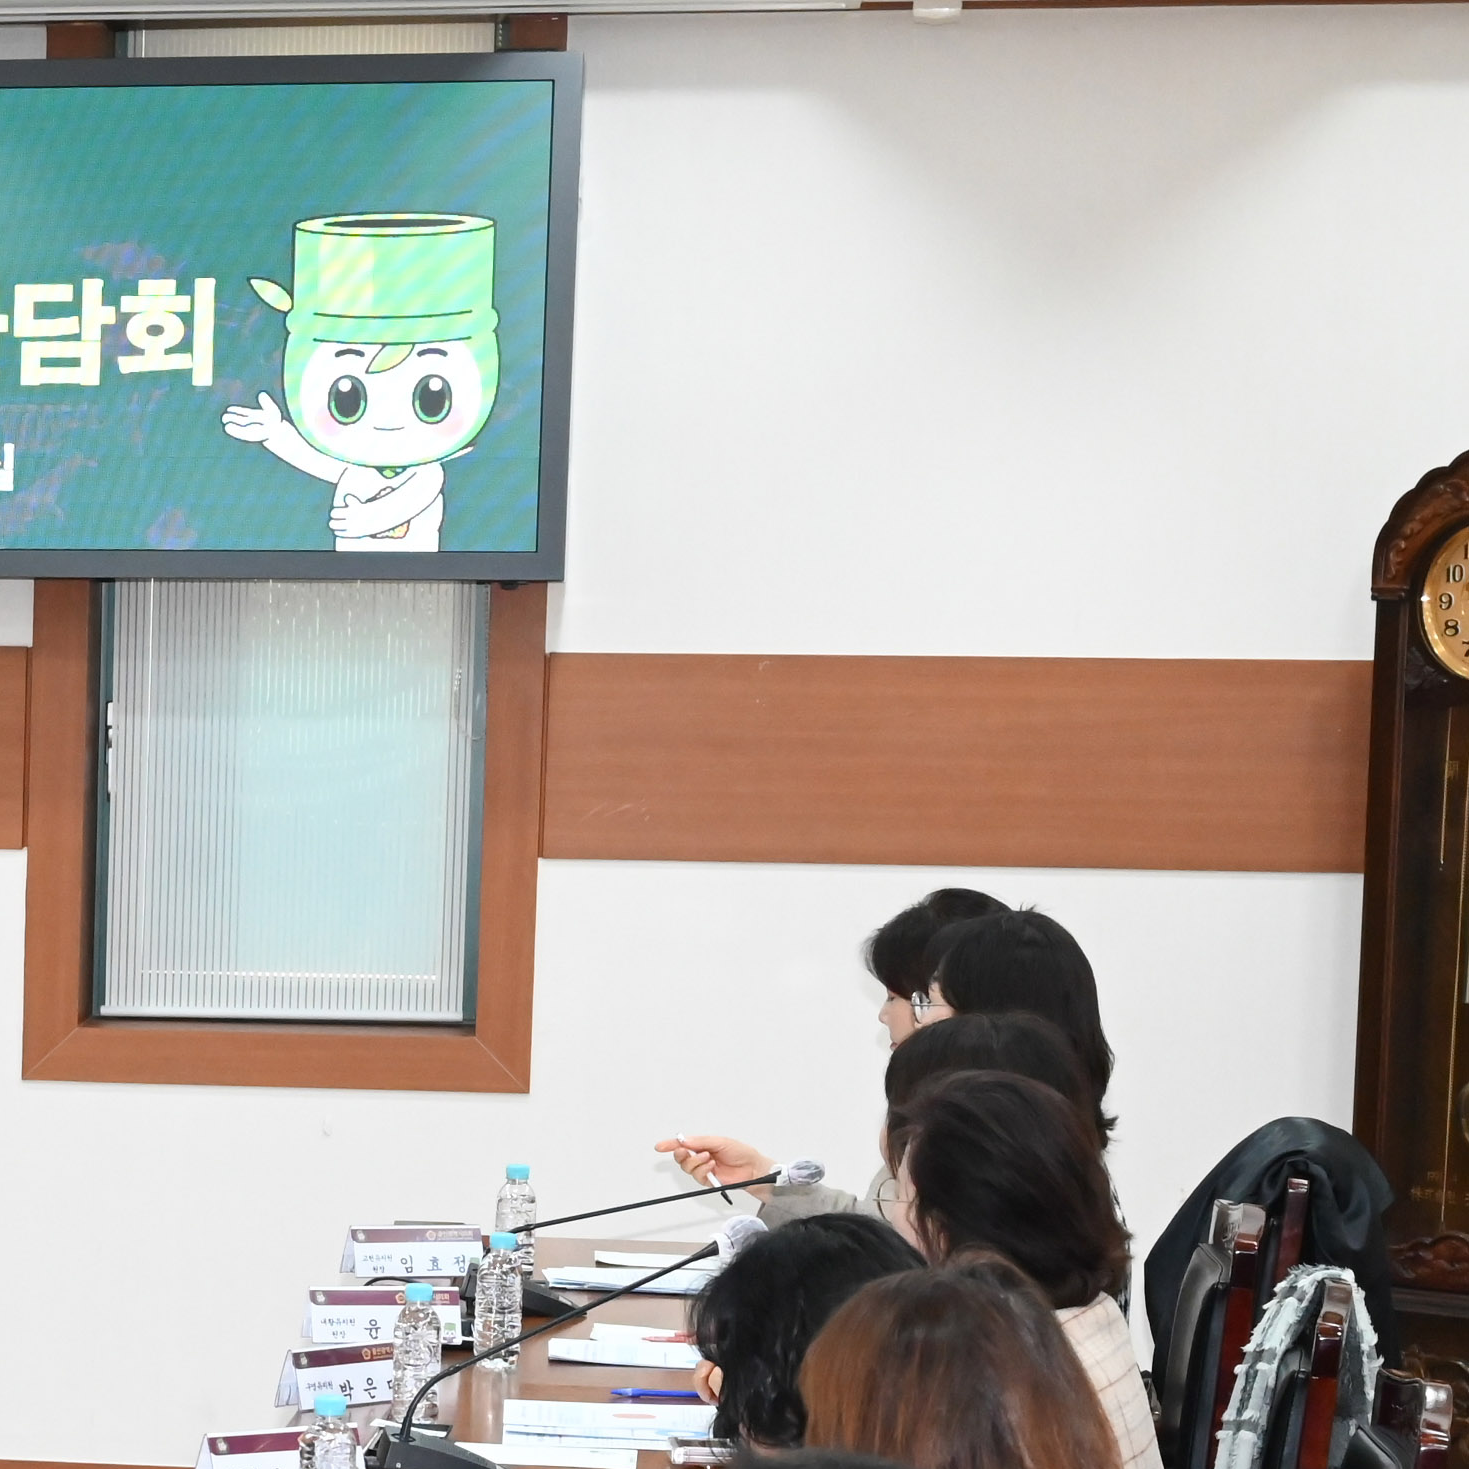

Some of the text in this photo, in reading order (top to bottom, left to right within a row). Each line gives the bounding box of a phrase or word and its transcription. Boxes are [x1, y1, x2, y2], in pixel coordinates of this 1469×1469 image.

[1446, 564, 1463, 583] 10
[1439, 592, 1453, 610] 9
[1444, 619, 1459, 636] 8
[400, 1254, 466, 1274] 임 효 정
[364, 1319, 382, 1340] 윤
[338, 1379, 354, 1401] 박
[363, 1377, 377, 1399] 은
